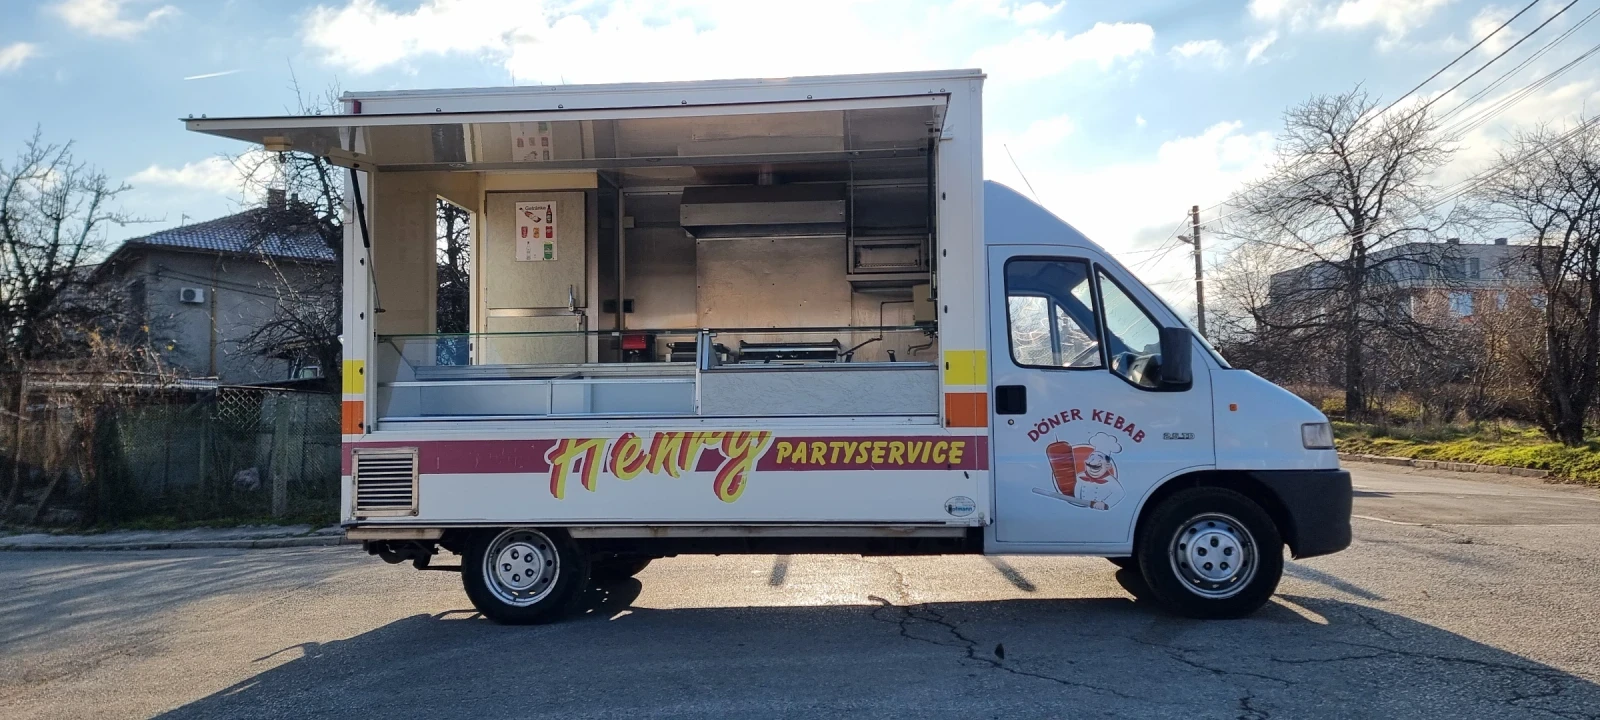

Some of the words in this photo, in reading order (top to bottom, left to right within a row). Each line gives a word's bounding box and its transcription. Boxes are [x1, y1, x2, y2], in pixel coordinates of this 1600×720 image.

[1027, 408, 1083, 443] DÖNER
[1092, 408, 1146, 443] KEBAB
[548, 431, 773, 503] Henry
[776, 440, 966, 465] PARTYSERVICE
